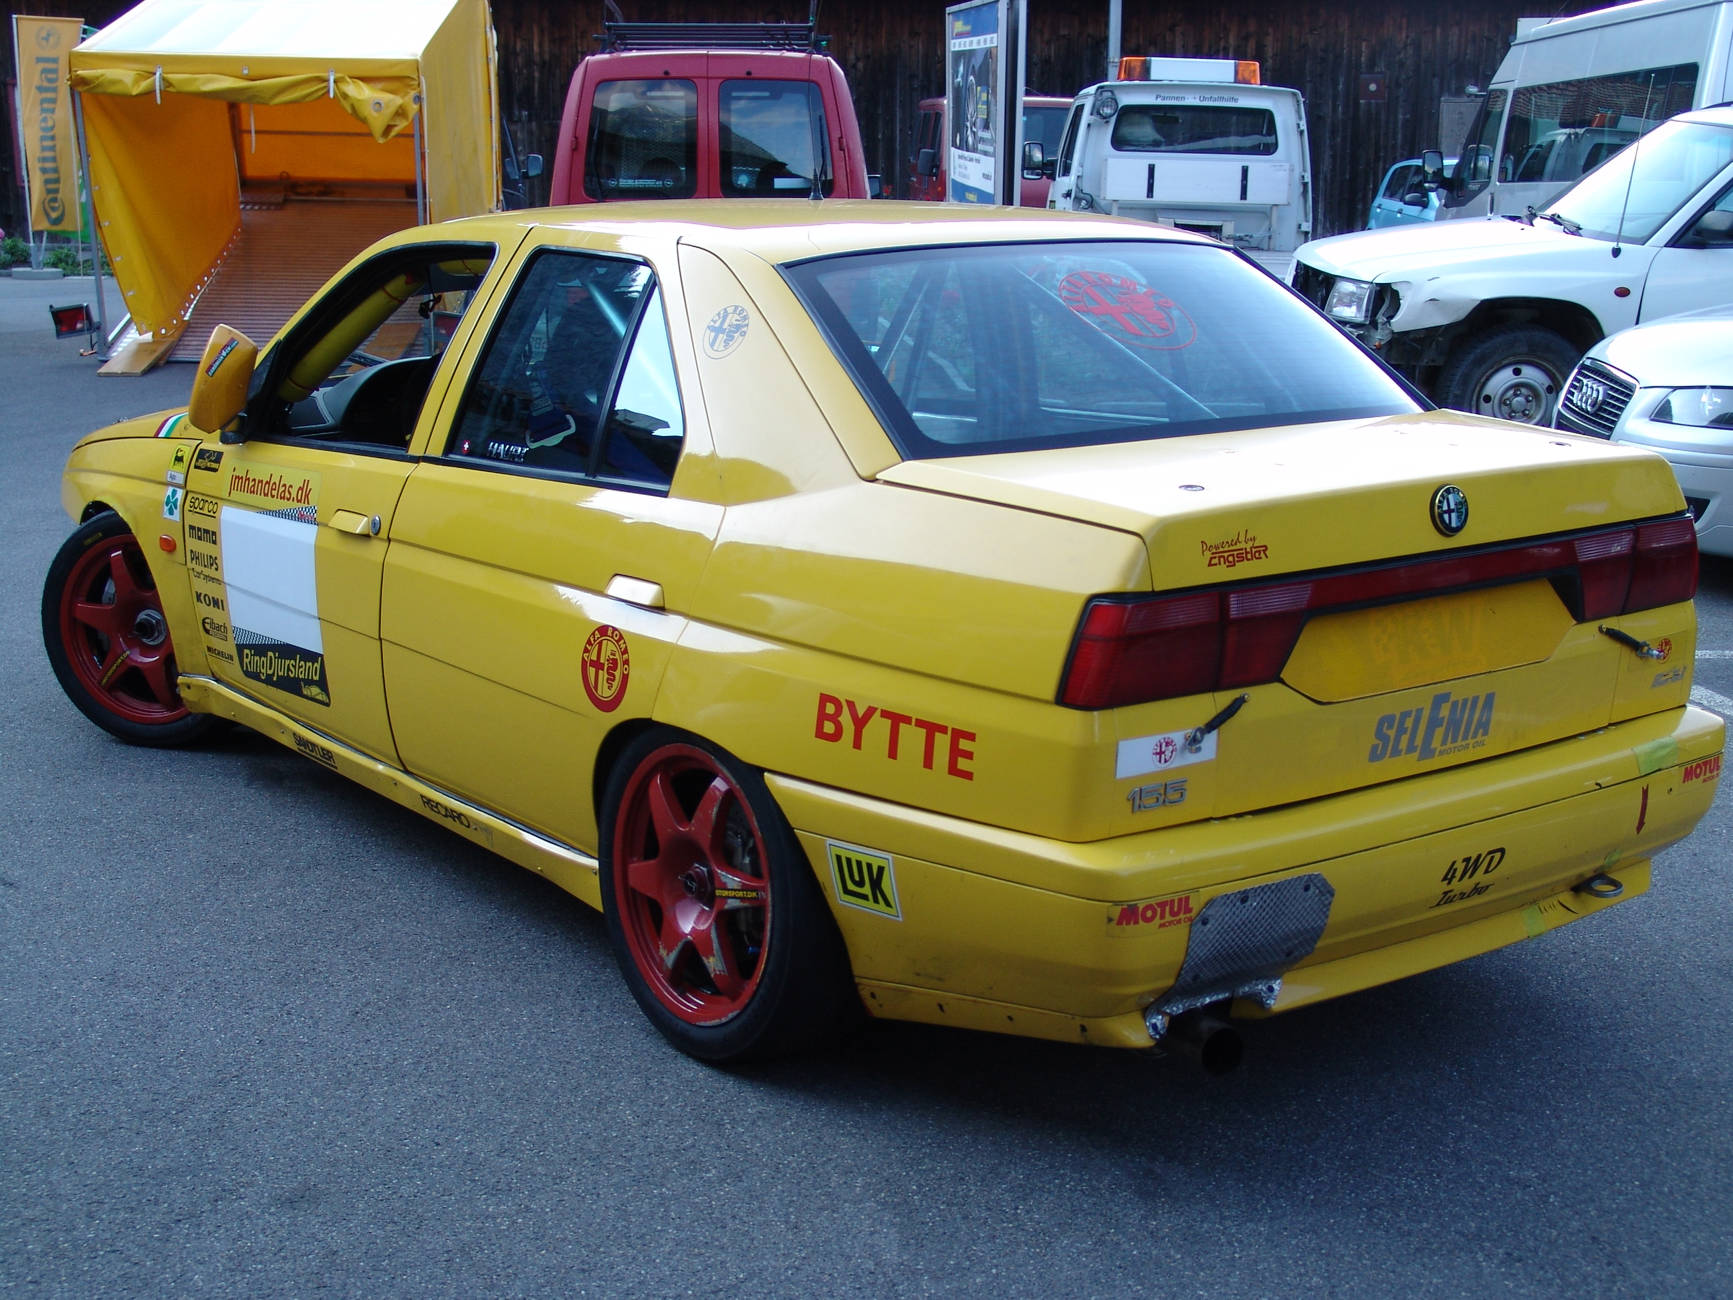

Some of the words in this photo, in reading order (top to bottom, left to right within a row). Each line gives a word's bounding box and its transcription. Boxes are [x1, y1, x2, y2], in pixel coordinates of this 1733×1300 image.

[35, 56, 65, 226] Continental
[228, 467, 312, 506] jmhandelas.dk
[189, 496, 219, 516] sparco
[1200, 531, 1242, 556] Powered
[1244, 528, 1257, 546] by
[190, 549, 219, 572] PHILIPS
[195, 591, 225, 611] KONI
[207, 645, 234, 662] MICHELIN
[243, 648, 321, 682] RingDjursland
[583, 630, 600, 661] ALFA
[607, 627, 629, 674] ROMEO
[814, 692, 977, 781] BYTTE
[1368, 692, 1496, 763] SELENIA
[1682, 756, 1720, 784] MOTUL
[420, 794, 471, 829] RECARO
[1127, 778, 1188, 813] 155
[1441, 847, 1506, 887] 4WD
[1116, 895, 1194, 926] MOTUL
